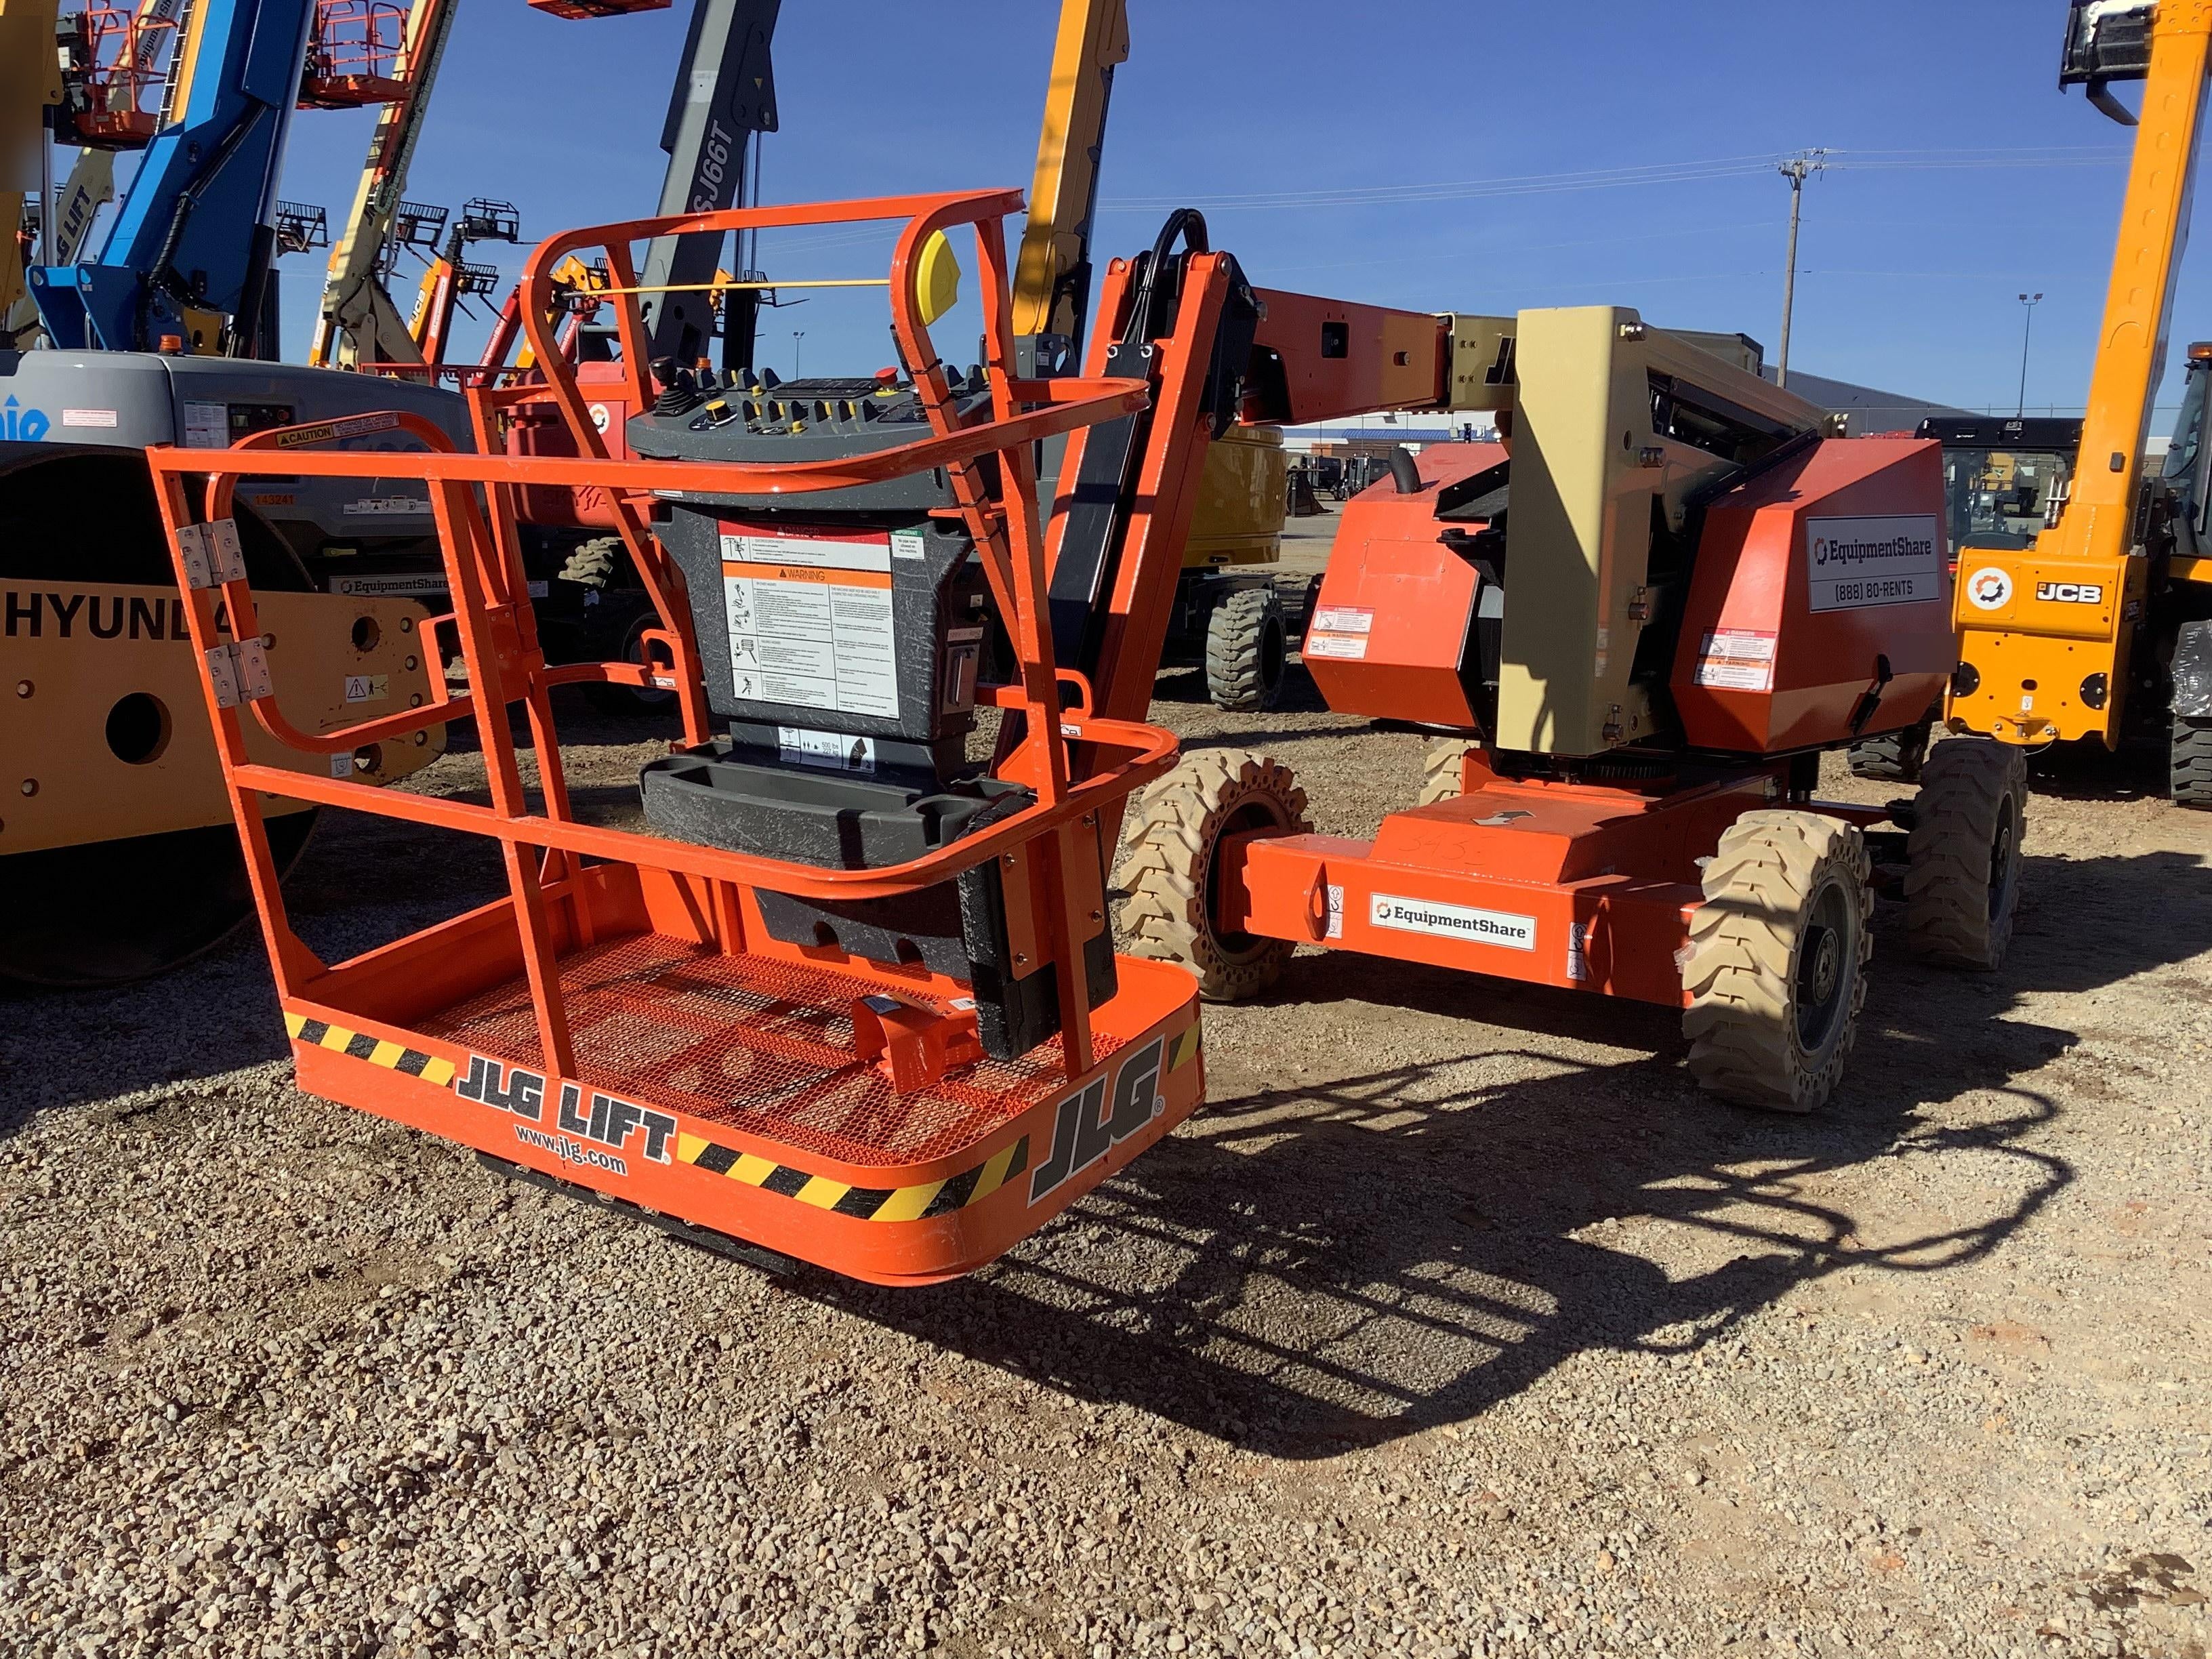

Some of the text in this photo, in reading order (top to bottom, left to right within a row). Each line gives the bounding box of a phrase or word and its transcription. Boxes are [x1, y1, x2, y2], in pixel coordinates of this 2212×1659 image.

[693, 119, 733, 213] SJ66T
[63, 184, 91, 239] LIFT
[412, 288, 427, 323] JCB
[289, 426, 331, 444] CAUTION
[255, 494, 294, 505] 143241
[785, 526, 821, 538] DANGER
[1829, 536, 1932, 565] EquipmentShare
[354, 578, 449, 593] EquipmentShare
[787, 569, 825, 581] WARNING
[1835, 580, 1913, 602] (888) 80-RENTS
[2036, 583, 2102, 604] JCB
[1394, 905, 1526, 939] EquipmentShare
[456, 1054, 678, 1164] JLG LIFT
[1027, 1033, 1166, 1209] JLG
[514, 1124, 628, 1176] www.jlg.com
